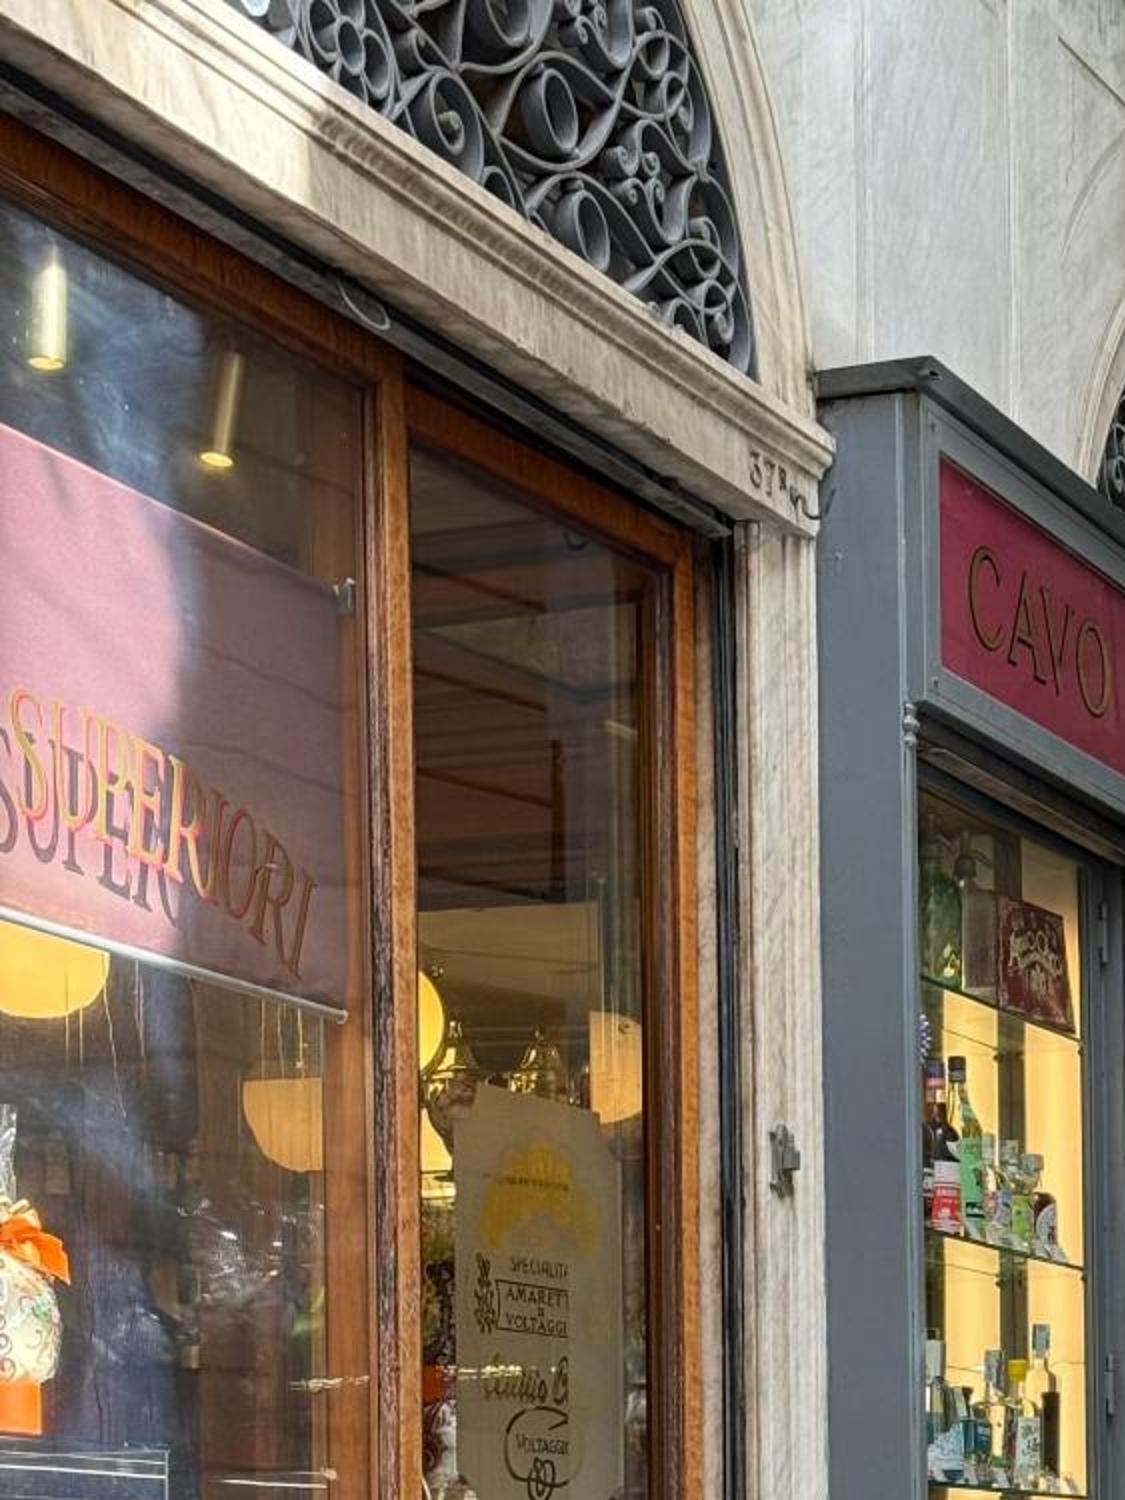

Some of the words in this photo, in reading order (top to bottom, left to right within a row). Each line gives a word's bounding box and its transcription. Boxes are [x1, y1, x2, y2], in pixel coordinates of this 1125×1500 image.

[968, 545, 1113, 718] CAVO
[8, 687, 318, 981] SUPERIORI
[505, 1287, 568, 1311] AMARETT
[505, 1312, 568, 1335] VOLTAGGI
